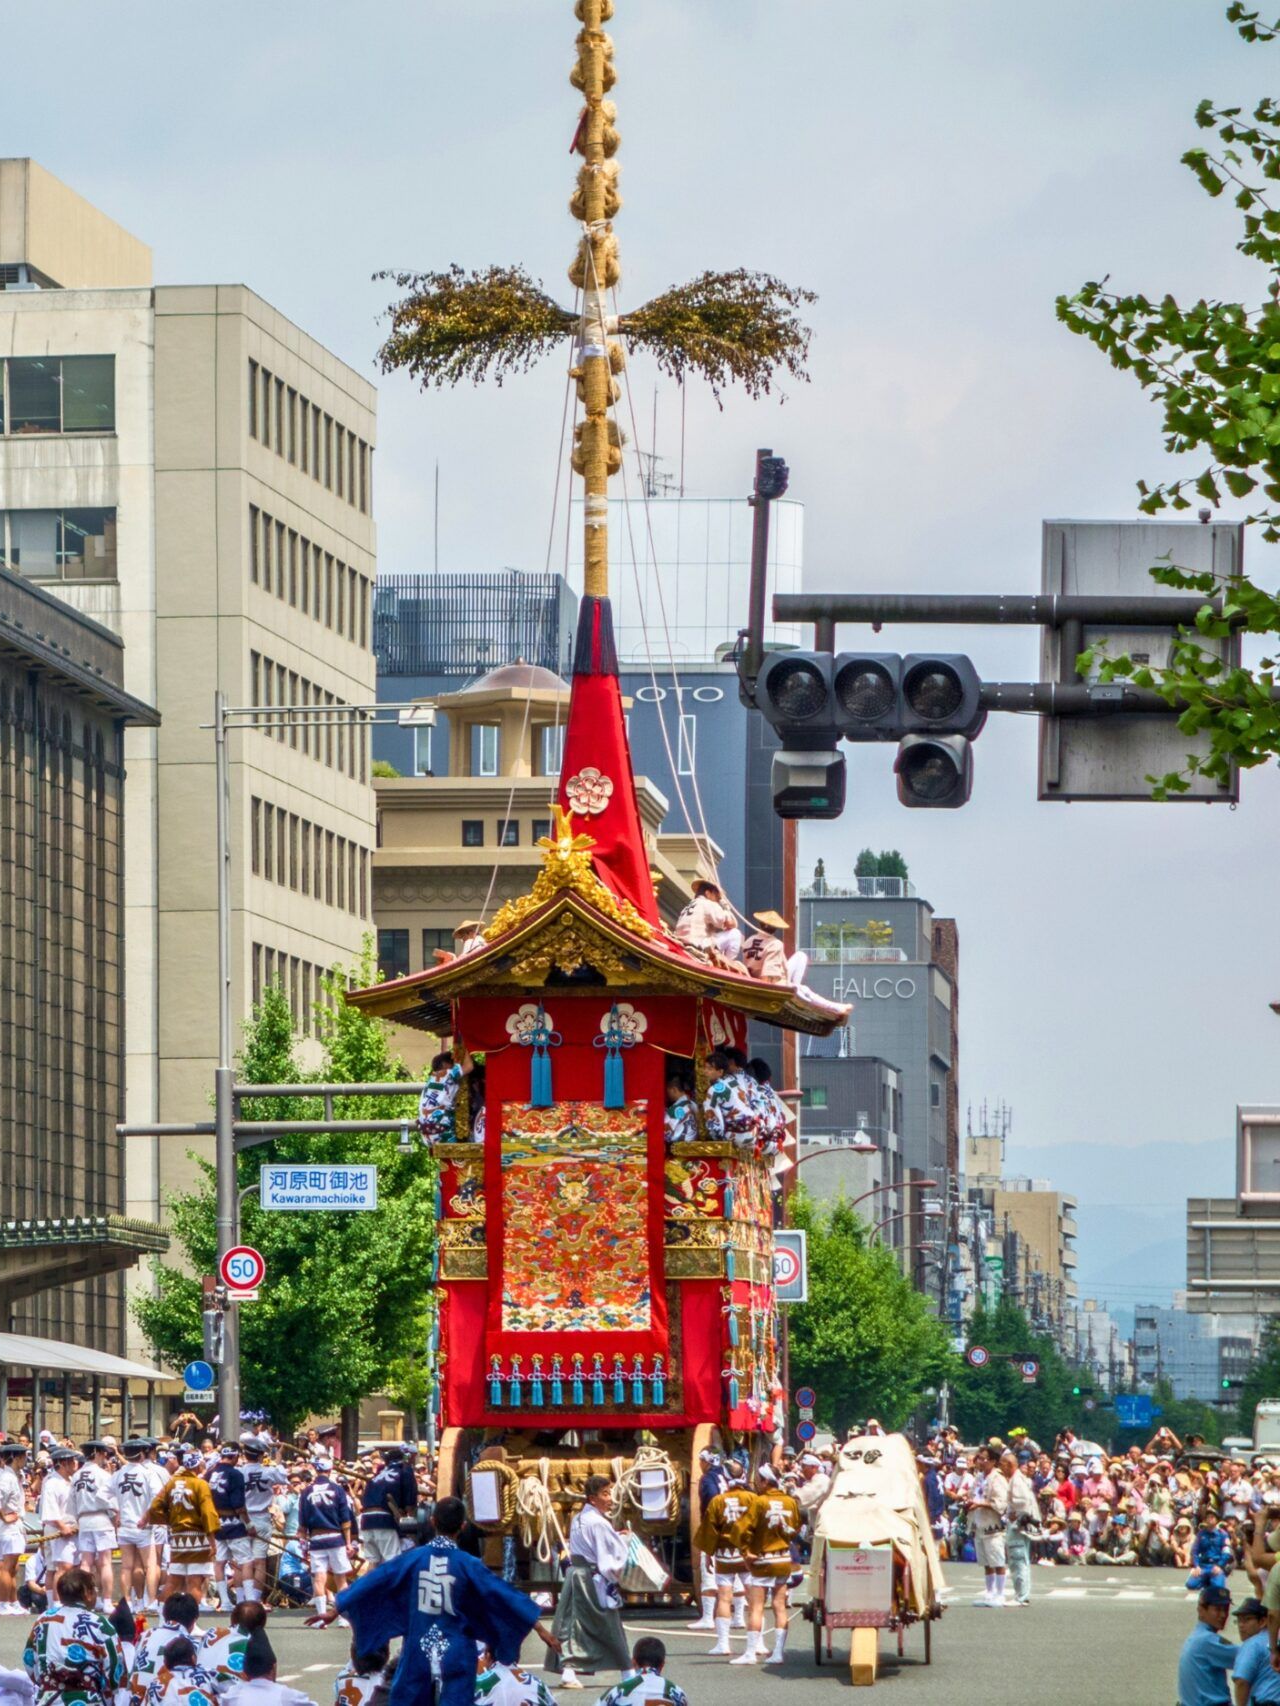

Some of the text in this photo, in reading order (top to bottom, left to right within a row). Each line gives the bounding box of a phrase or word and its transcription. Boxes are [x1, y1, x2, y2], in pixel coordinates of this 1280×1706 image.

[833, 978, 916, 999] FALCO
[269, 1171, 368, 1190] 河原町御池
[271, 1193, 365, 1204] Kawaramachioike
[231, 1259, 254, 1278] 50
